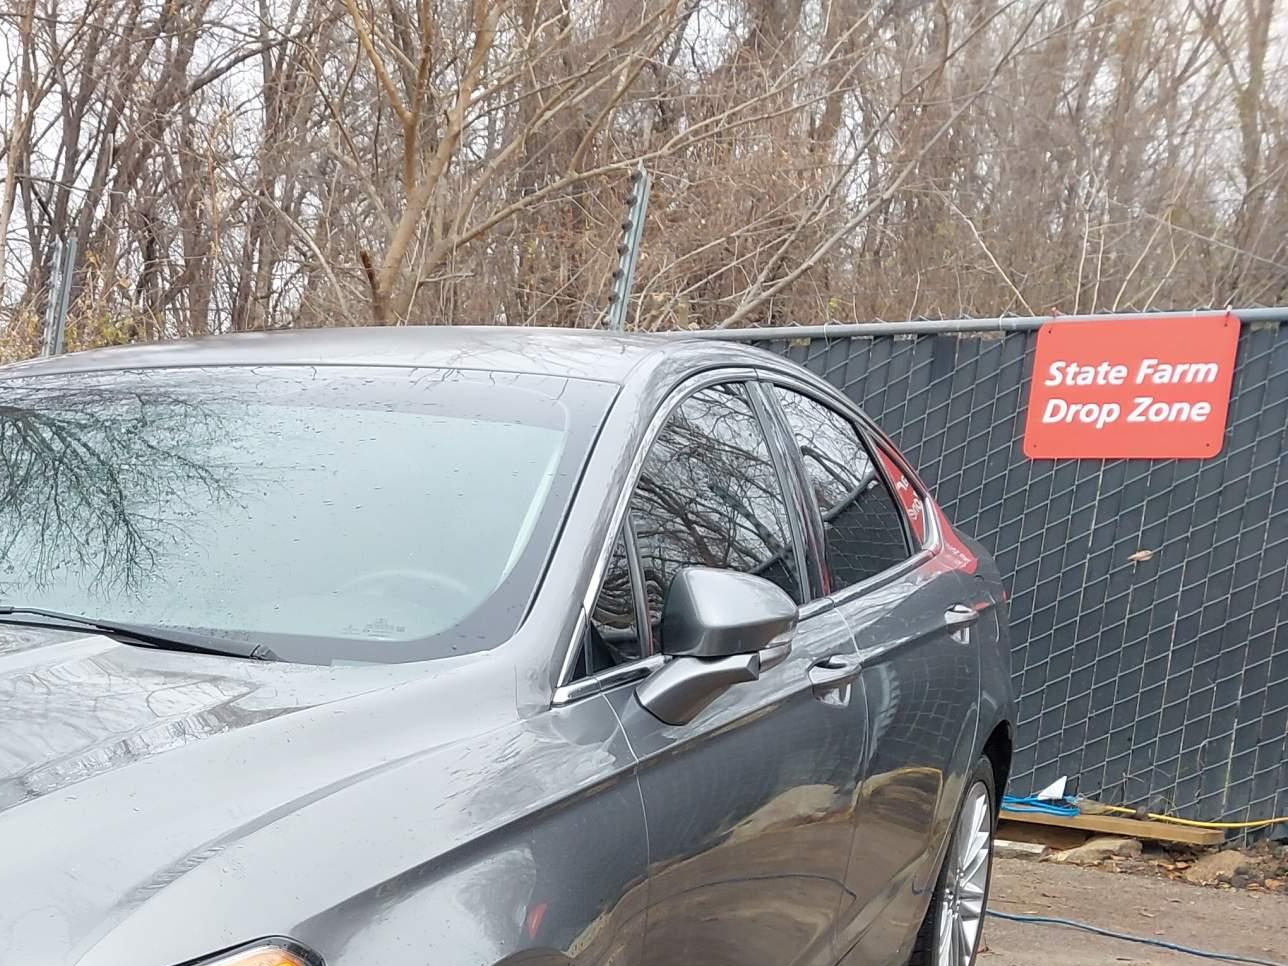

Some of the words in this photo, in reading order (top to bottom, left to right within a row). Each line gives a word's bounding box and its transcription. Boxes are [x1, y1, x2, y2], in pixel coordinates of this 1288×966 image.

[1044, 361, 1128, 387] State
[1135, 359, 1219, 385] Farm
[1042, 398, 1121, 429] Drop
[1127, 397, 1212, 423] Zone
